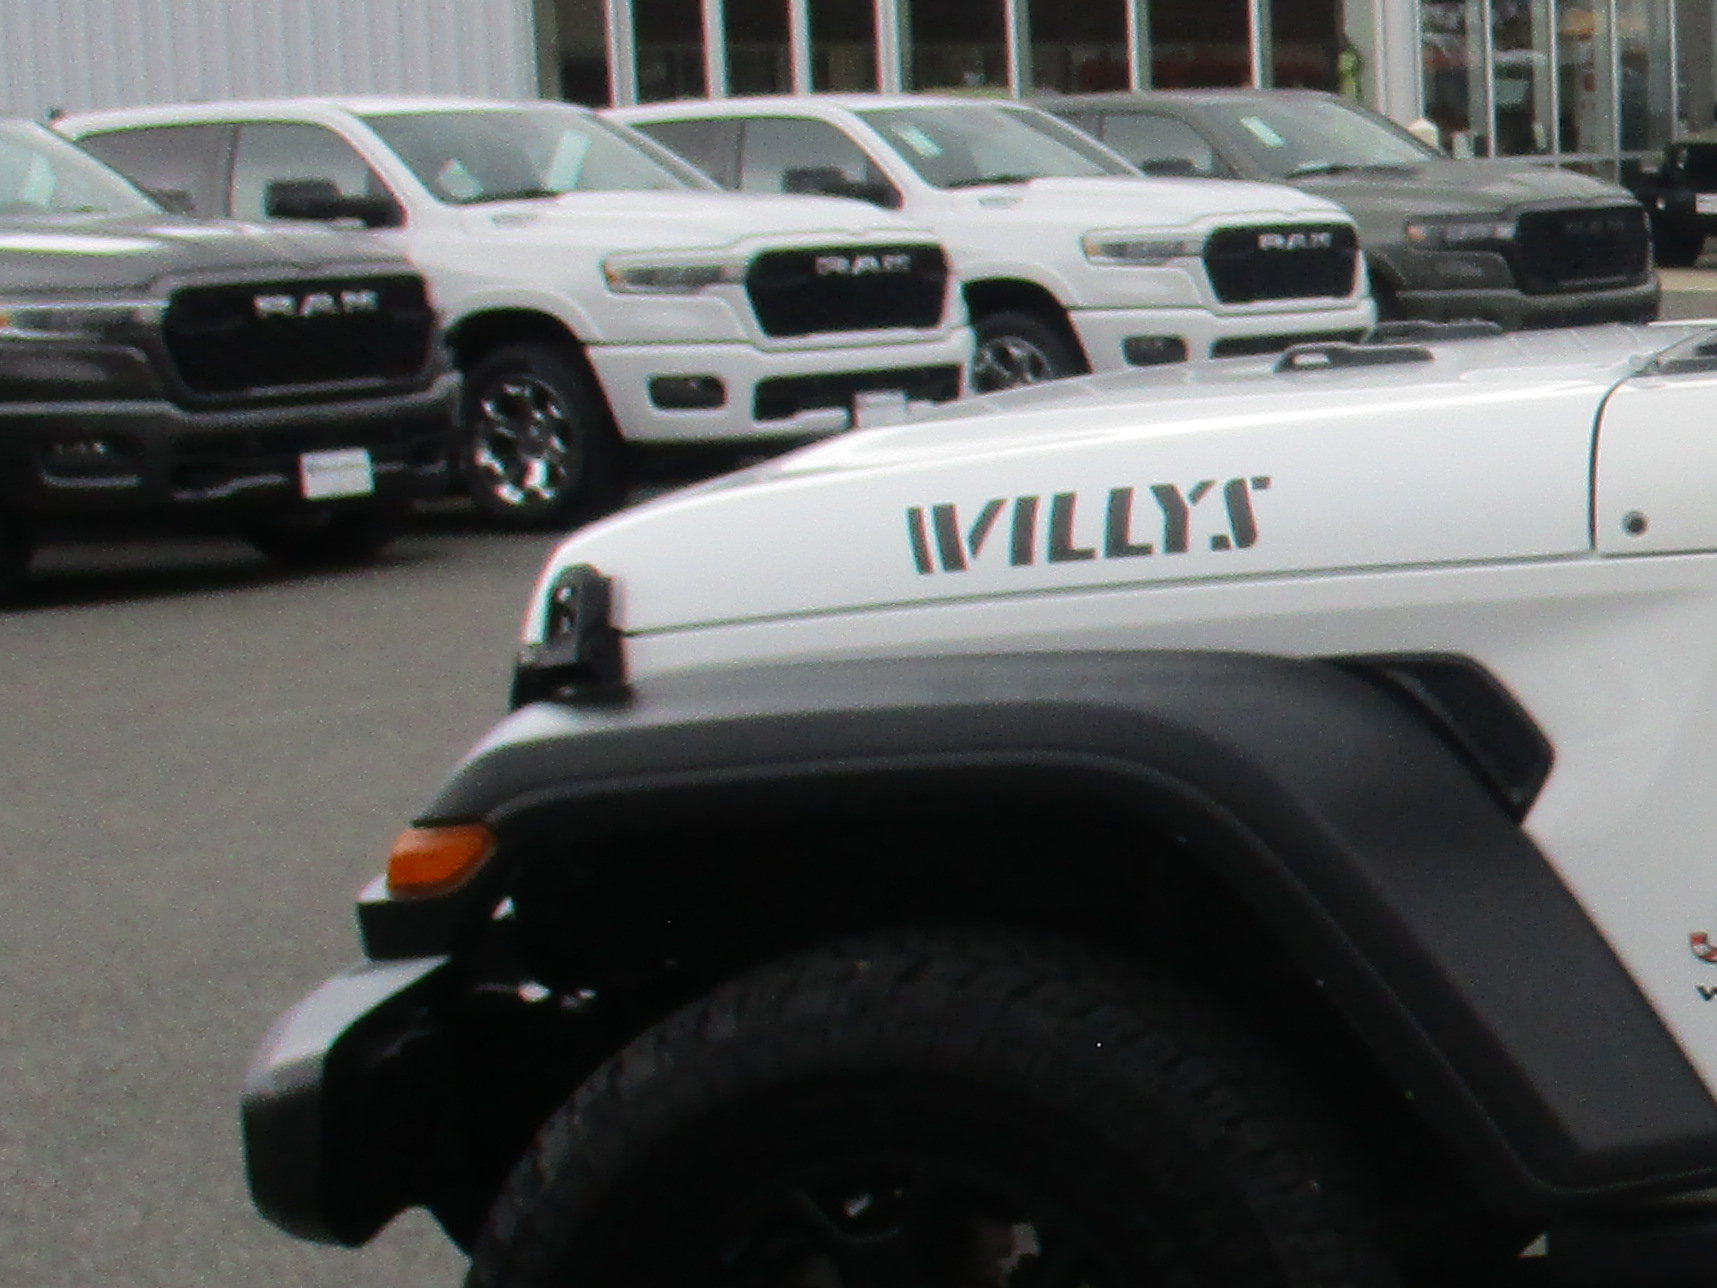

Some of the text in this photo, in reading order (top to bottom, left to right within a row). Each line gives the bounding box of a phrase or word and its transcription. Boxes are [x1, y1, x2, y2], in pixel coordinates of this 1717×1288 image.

[814, 254, 912, 276] RAM
[253, 289, 380, 319] RAM
[906, 475, 1273, 575] WILLYS
